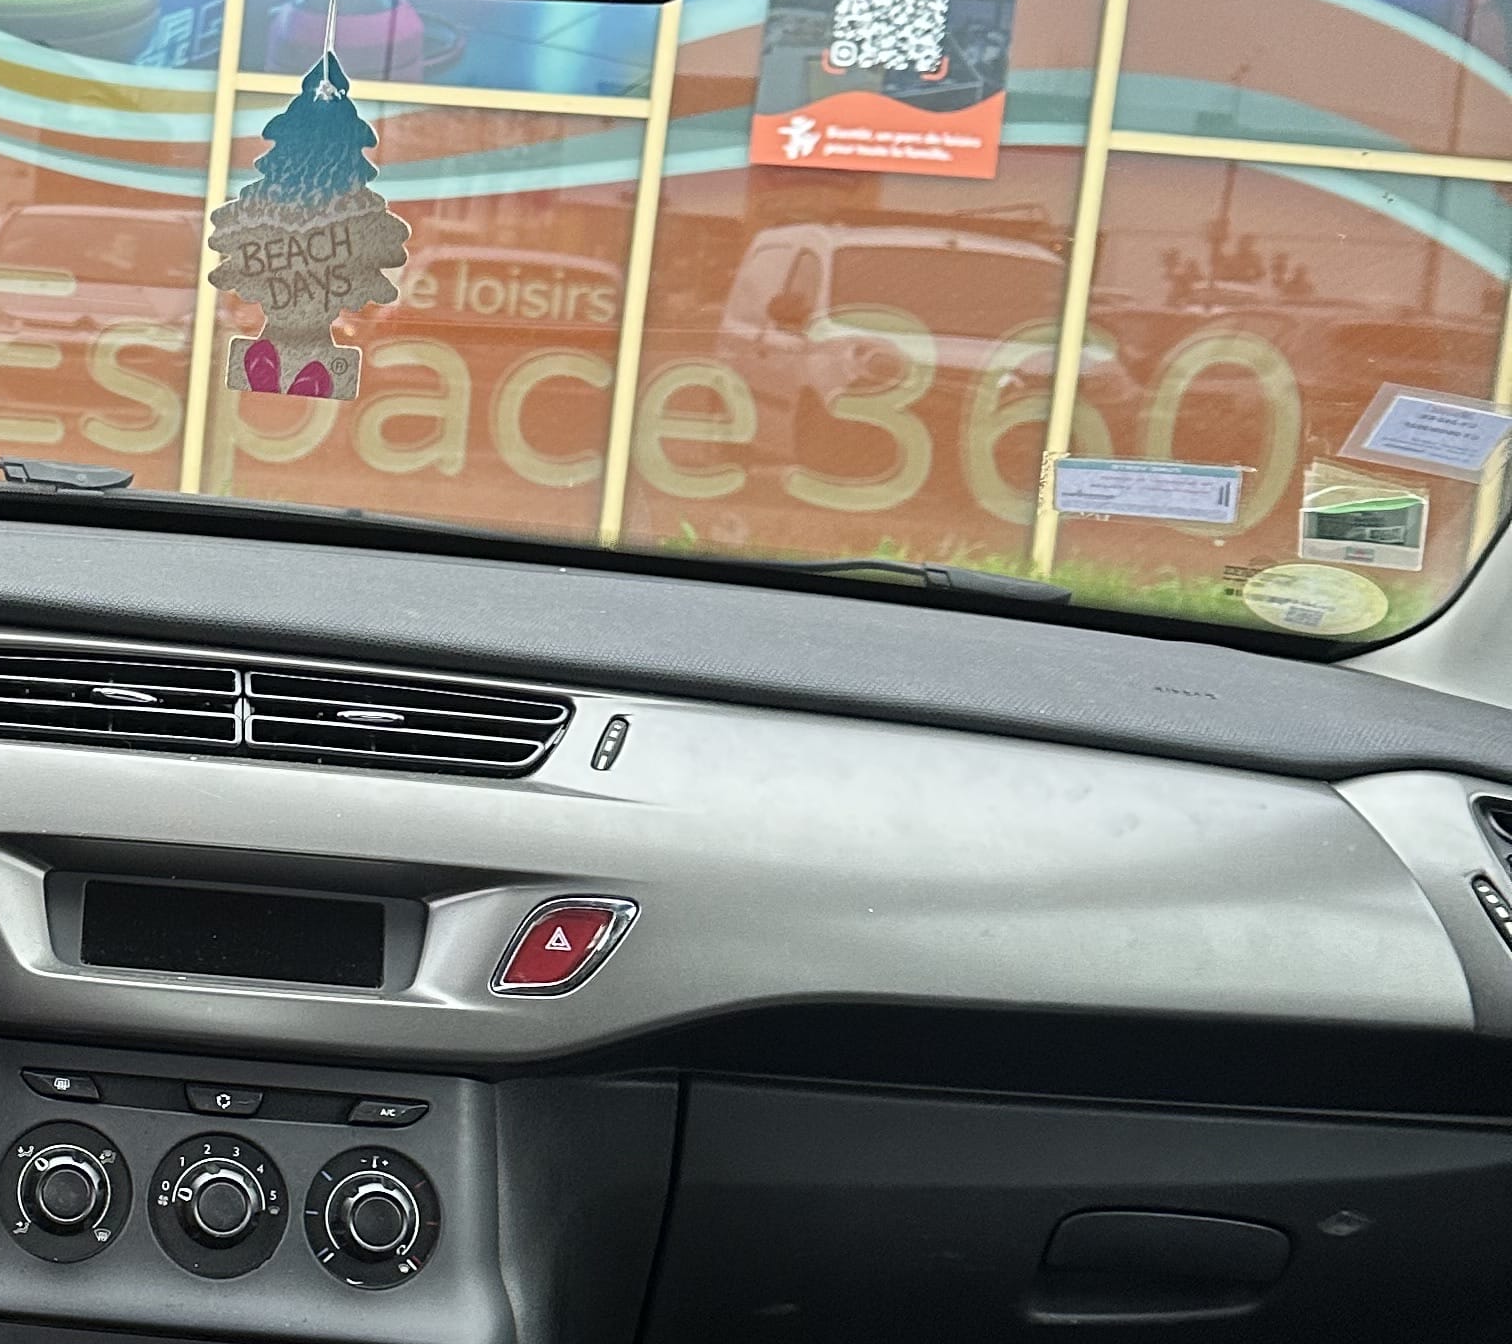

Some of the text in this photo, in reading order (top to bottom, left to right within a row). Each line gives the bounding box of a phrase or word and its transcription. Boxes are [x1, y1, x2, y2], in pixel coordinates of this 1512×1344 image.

[240, 224, 352, 277] BEACH
[266, 264, 352, 312] DAYS
[455, 259, 617, 323] loisirs
[380, 1107, 396, 1117] A/C
[203, 1143, 212, 1155] 2
[232, 1146, 241, 1158] 3
[179, 1156, 186, 1168] 1
[256, 1163, 265, 1175] 4
[161, 1180, 170, 1192] 0
[269, 1190, 278, 1202] 5
